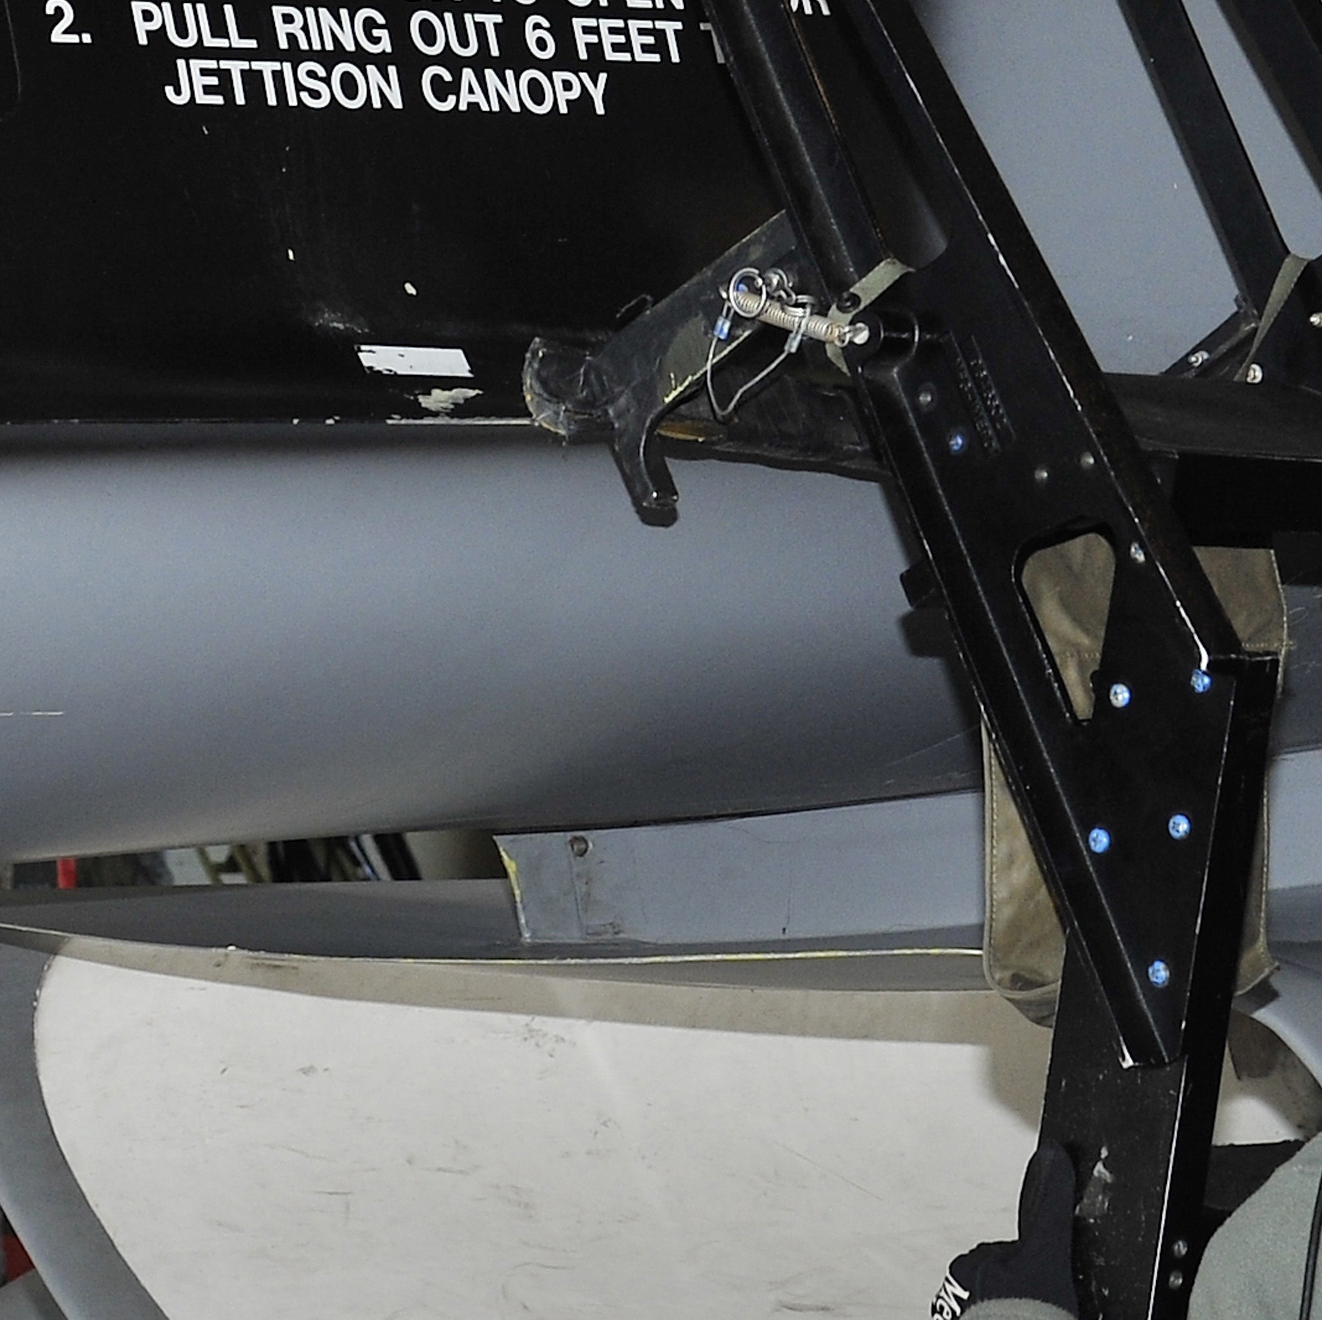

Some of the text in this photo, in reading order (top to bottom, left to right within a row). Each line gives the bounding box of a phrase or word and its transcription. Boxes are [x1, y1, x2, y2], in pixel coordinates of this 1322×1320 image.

[130, 0, 258, 49] PULL
[271, 5, 393, 54] RING
[409, 10, 504, 57] OUT
[524, 14, 556, 60] 6
[571, 17, 684, 63] FEET
[164, 58, 608, 115] JETTISON CANOPY
